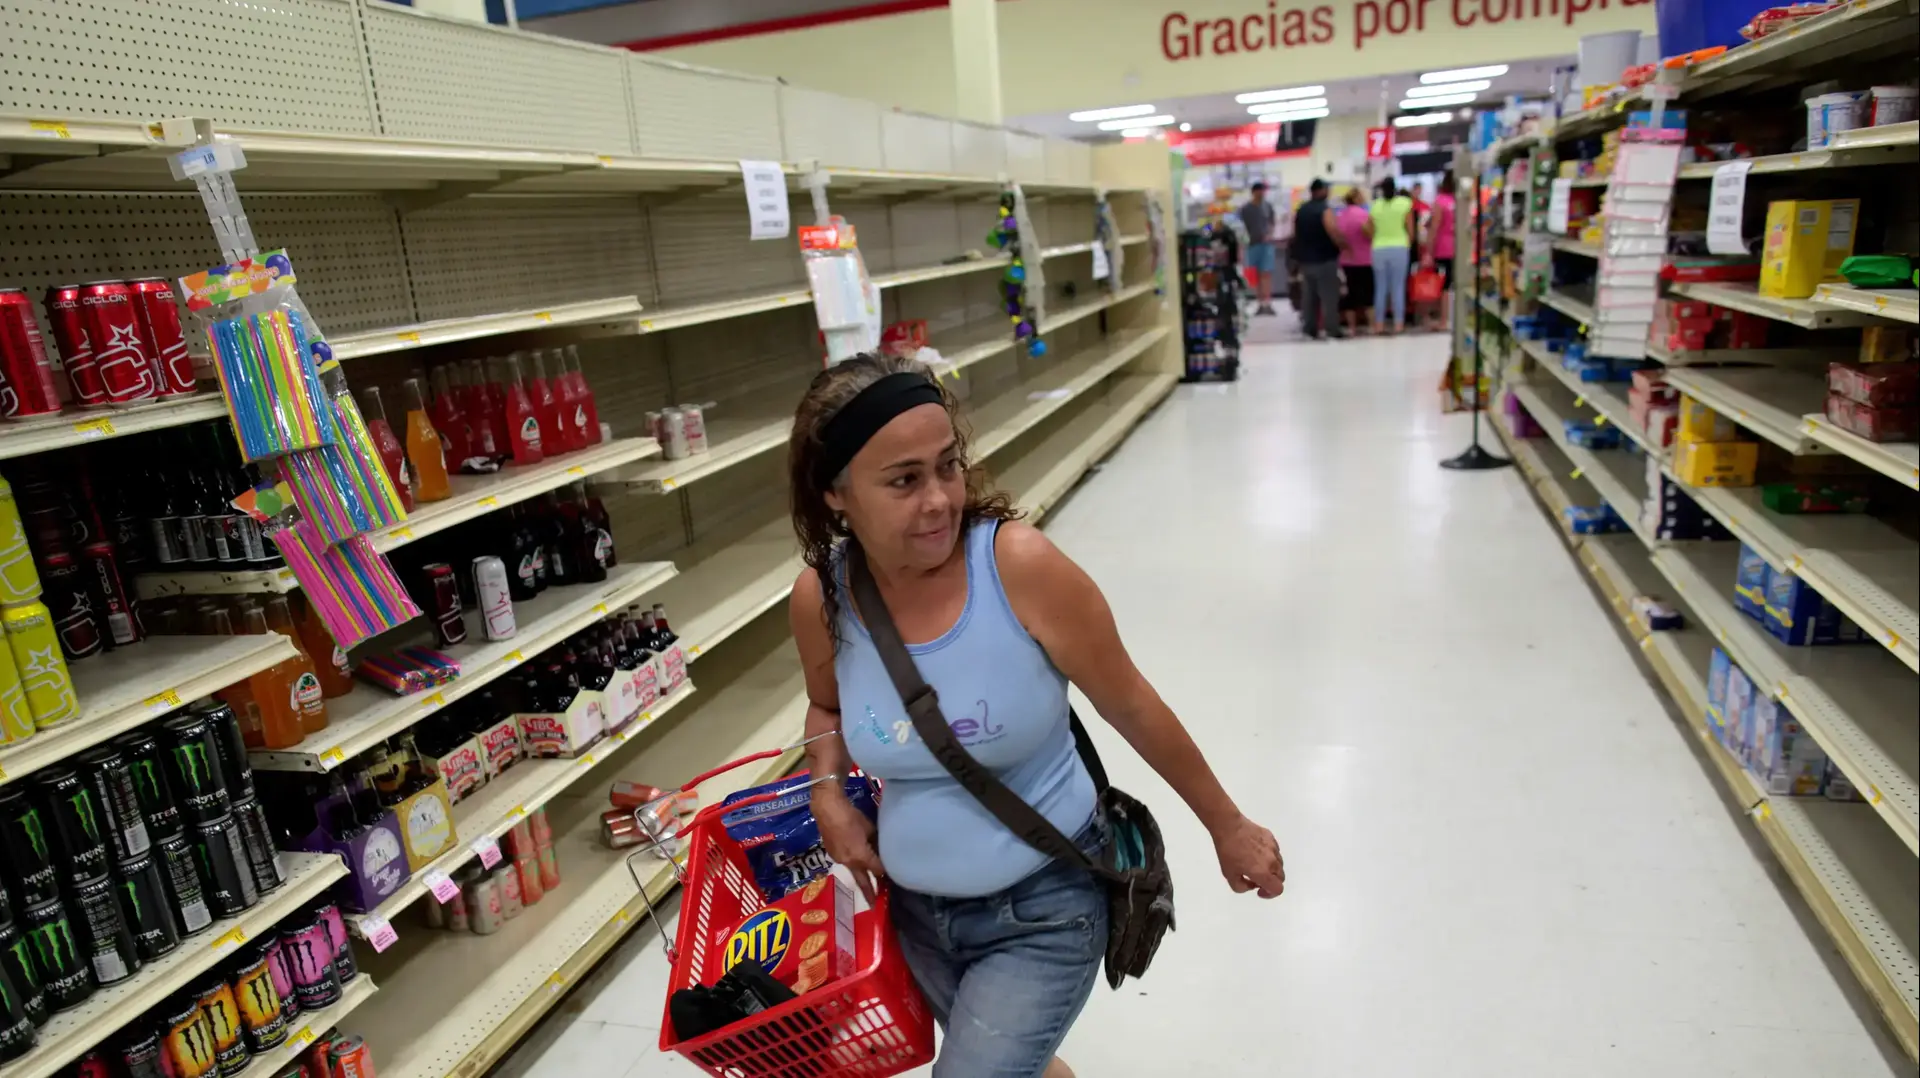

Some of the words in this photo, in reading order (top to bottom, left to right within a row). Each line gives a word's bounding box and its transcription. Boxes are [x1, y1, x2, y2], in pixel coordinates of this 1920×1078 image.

[1161, 2, 1336, 61] Gracias
[1354, 0, 1428, 50] por
[1368, 133, 1387, 156] 7
[753, 792, 810, 815] RESEALABL
[727, 910, 787, 973] RITZ
